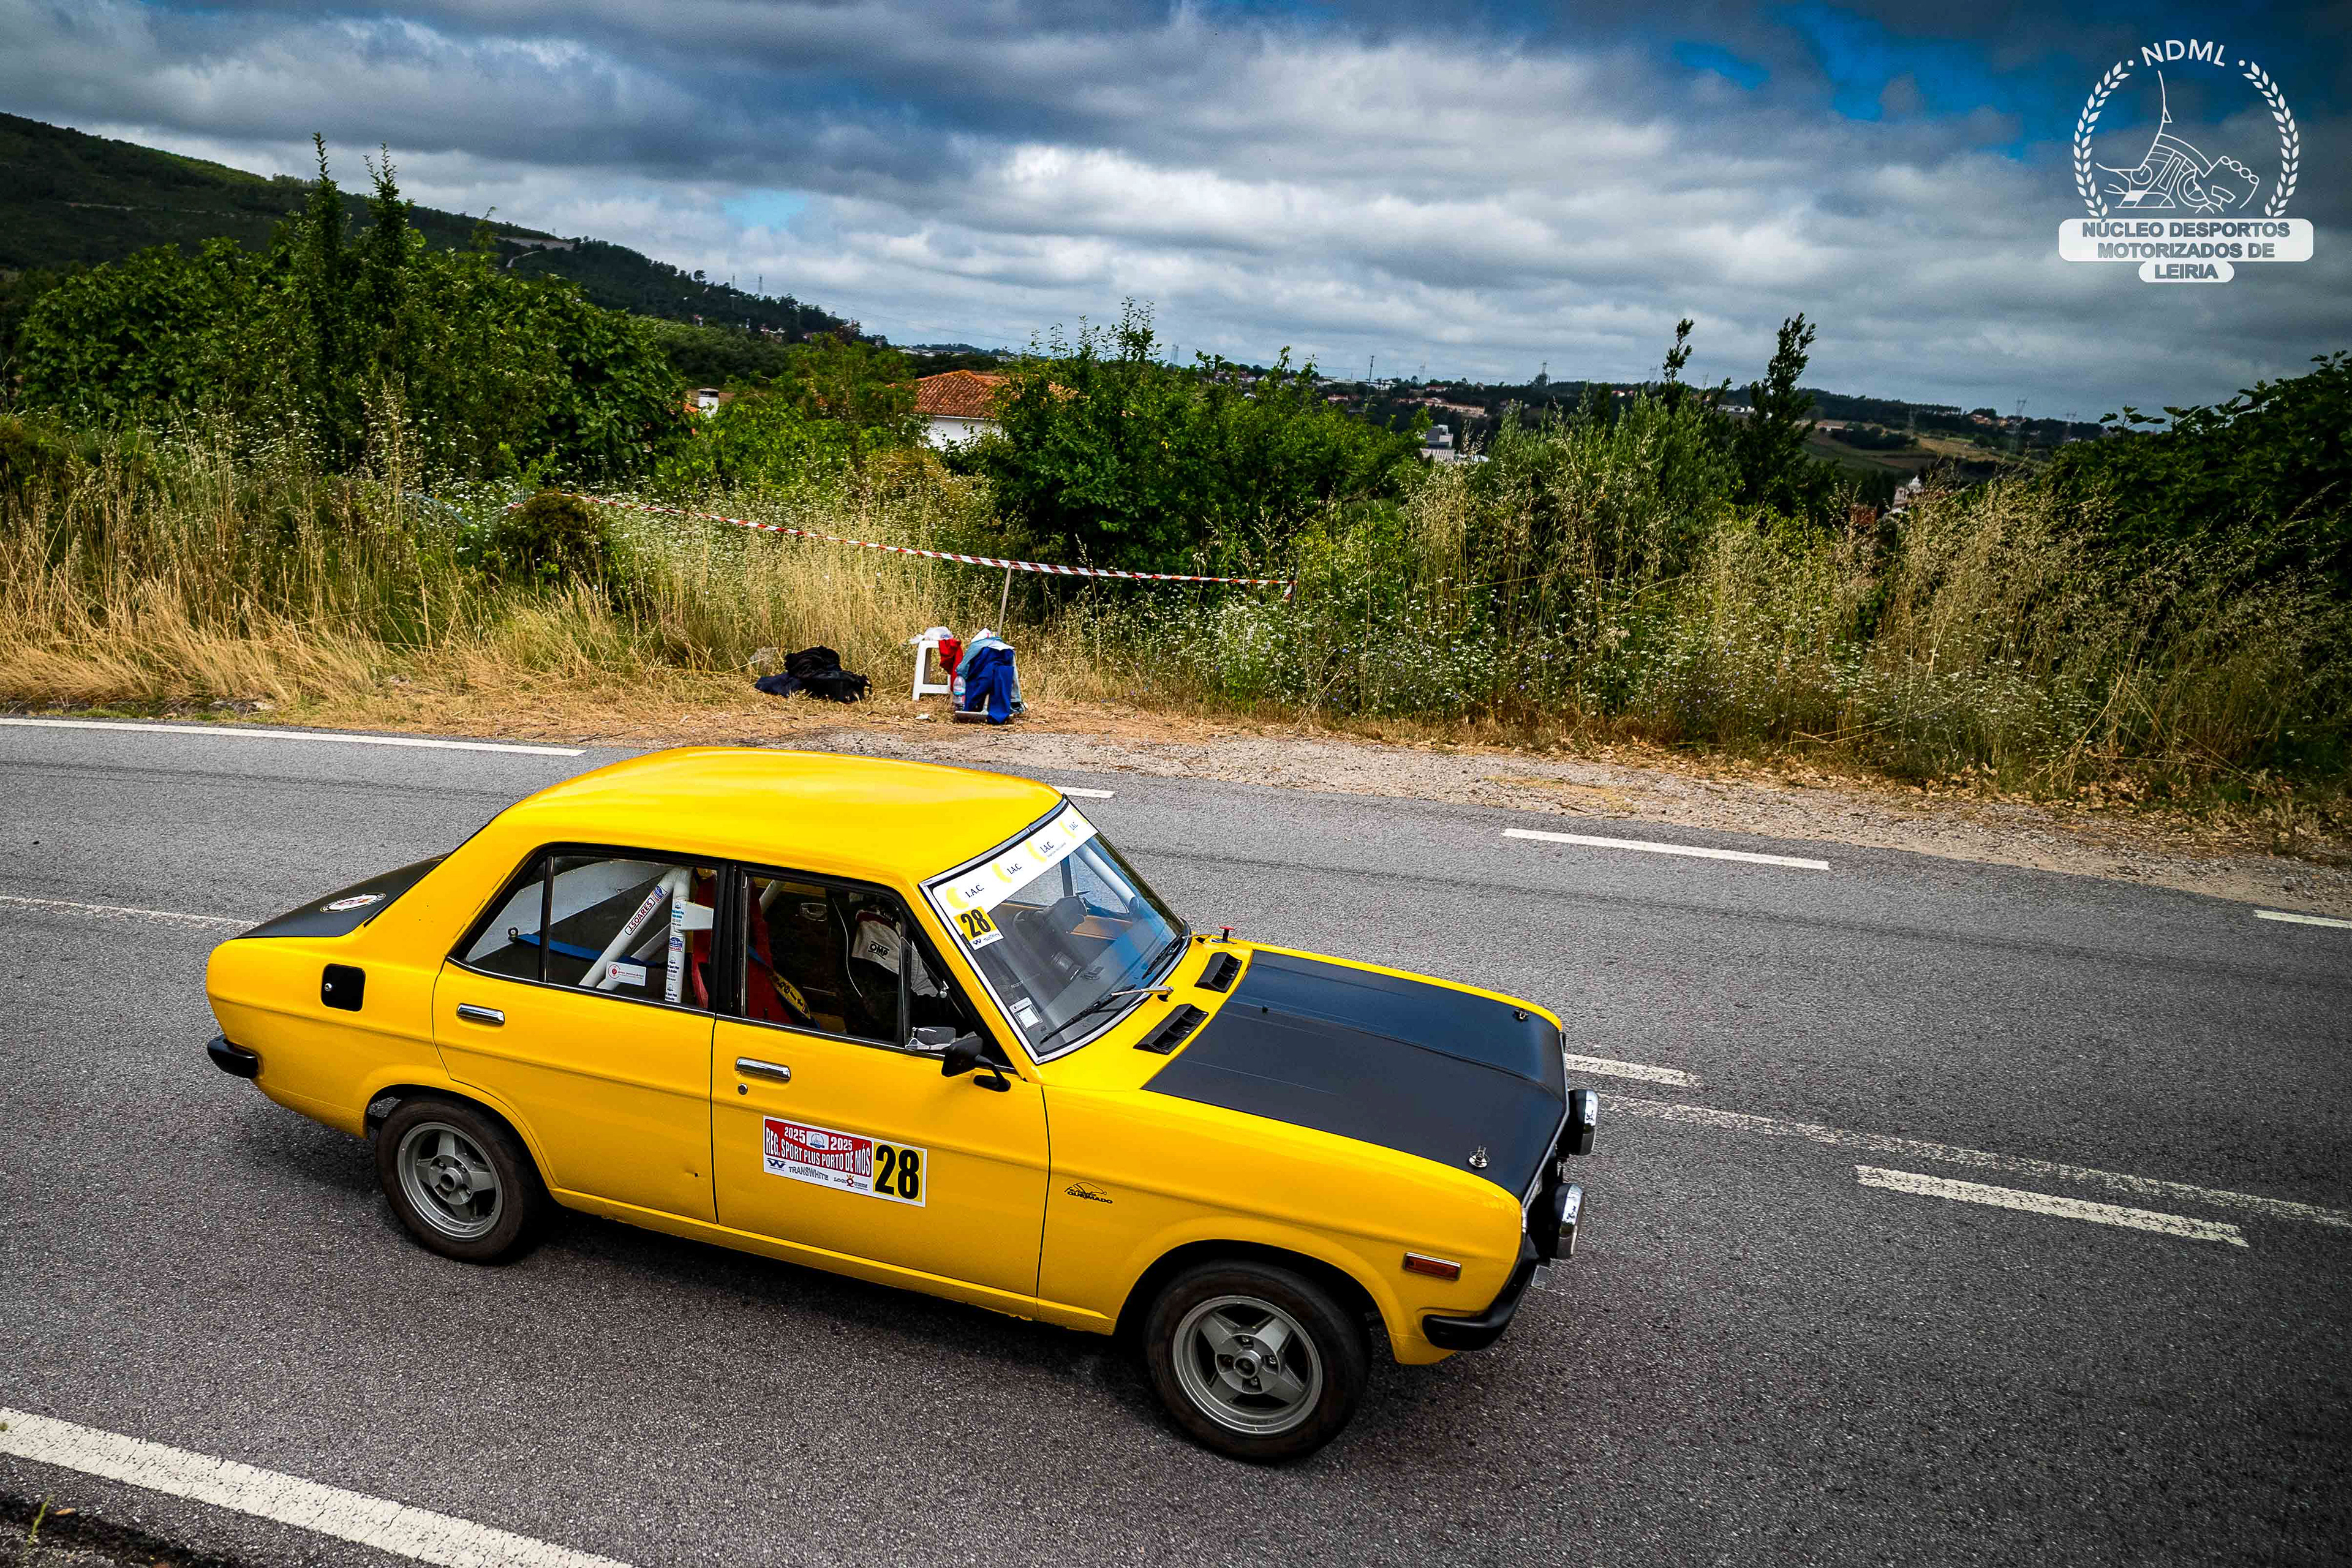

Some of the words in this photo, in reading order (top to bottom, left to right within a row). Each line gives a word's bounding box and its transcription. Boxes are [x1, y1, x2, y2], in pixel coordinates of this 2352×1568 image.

[628, 901, 652, 932] J.SOARES
[960, 909, 991, 938] 28
[870, 943, 888, 956] OMP
[766, 1127, 780, 1156] REG.
[781, 1138, 802, 1160] SPORT
[804, 1149, 820, 1167] PLUS
[821, 1153, 843, 1170] PORTO
[845, 1152, 854, 1172] DE
[855, 1143, 870, 1176] MÓS
[784, 1126, 805, 1144] 2025
[830, 1136, 853, 1150] 2025
[789, 1166, 829, 1181] TRANSWHITE
[874, 1144, 919, 1200] 28
